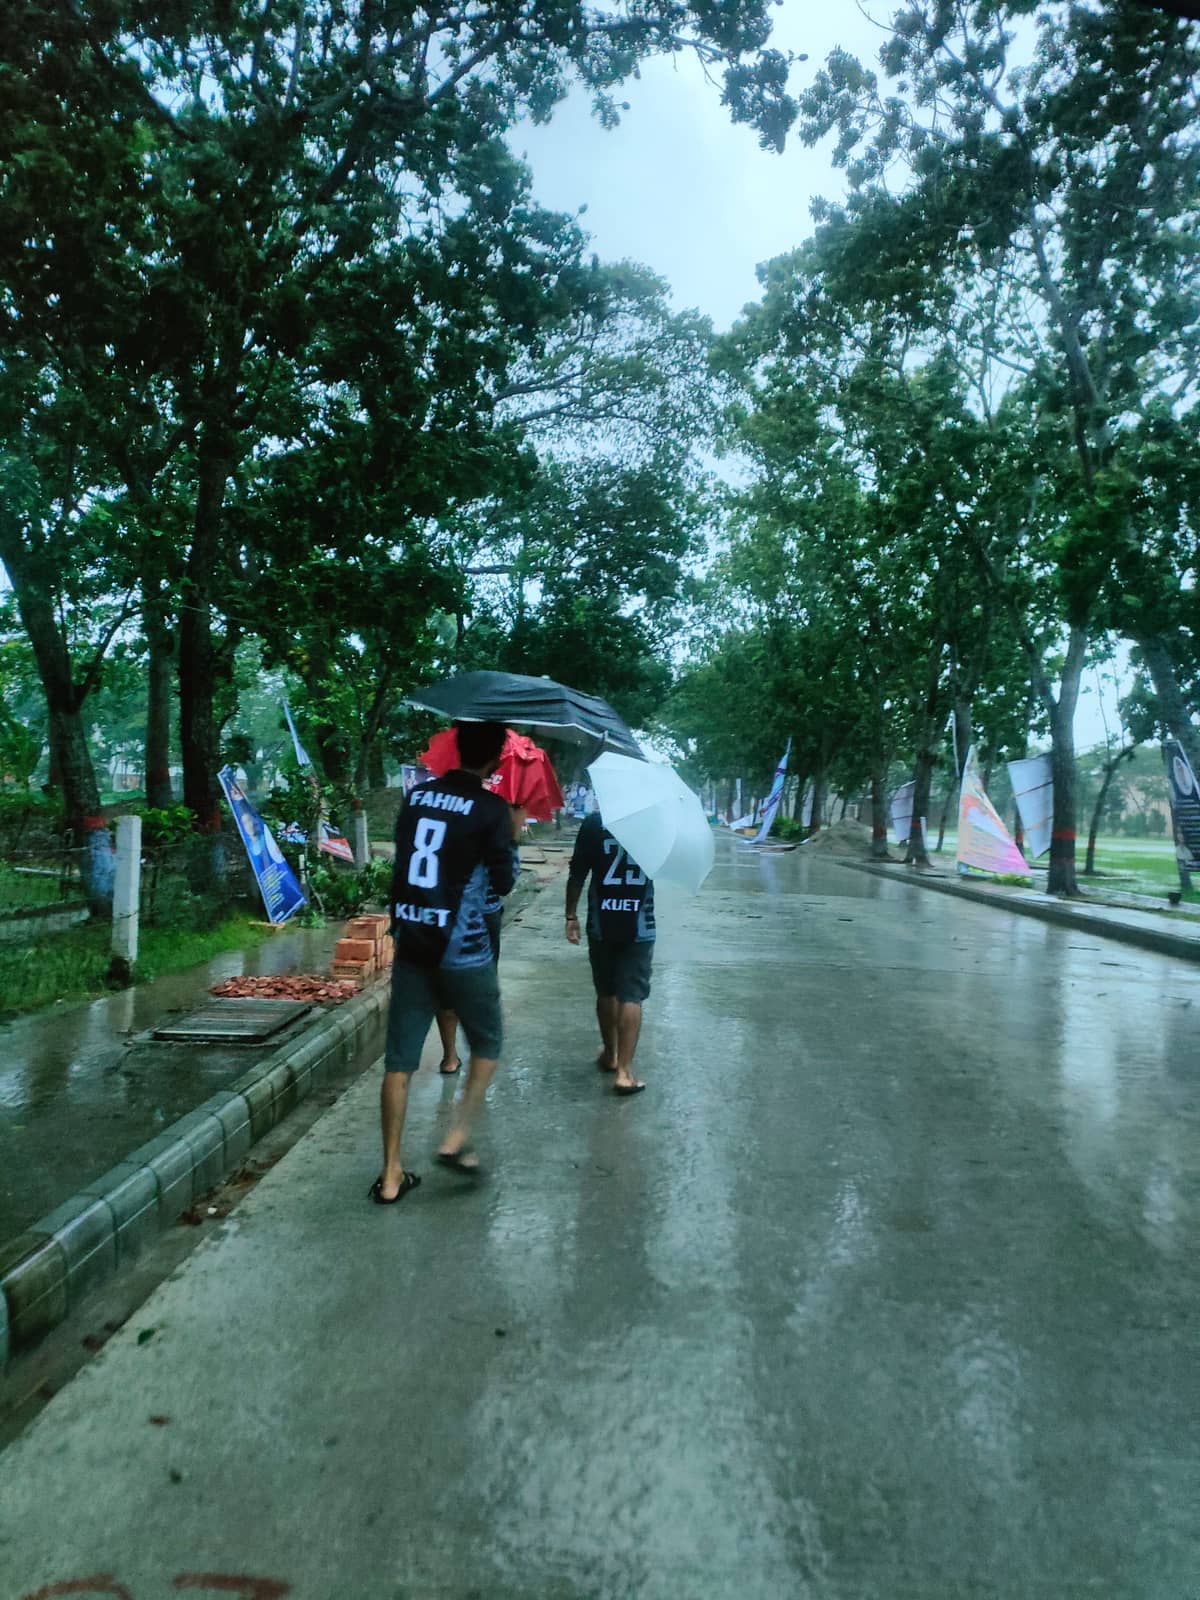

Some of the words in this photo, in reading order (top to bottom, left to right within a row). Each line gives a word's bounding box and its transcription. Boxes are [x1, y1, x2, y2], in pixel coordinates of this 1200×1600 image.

[410, 790, 474, 815] FAHIM
[408, 817, 447, 889] 8
[396, 903, 452, 927] KUET
[601, 898, 641, 912] KUET
